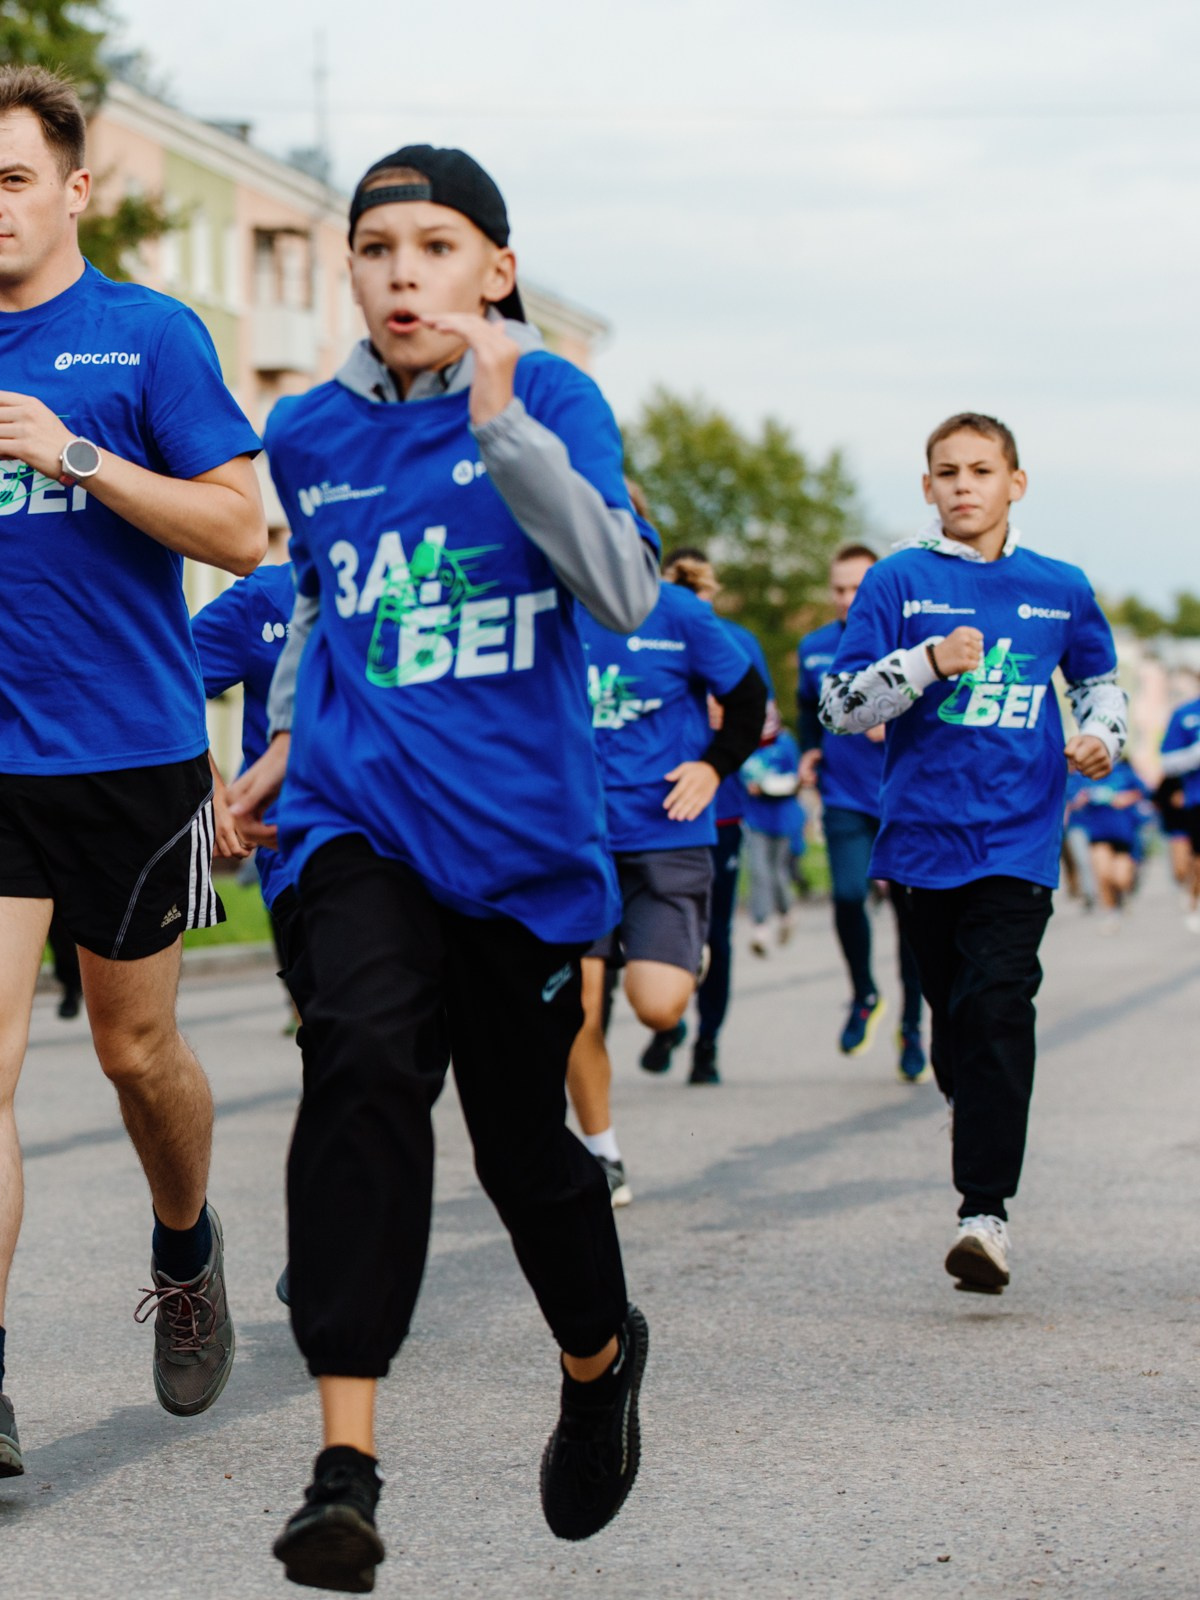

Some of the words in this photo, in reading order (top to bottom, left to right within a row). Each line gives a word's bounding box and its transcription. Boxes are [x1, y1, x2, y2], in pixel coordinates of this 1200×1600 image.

[73, 352, 140, 366] РОСАТОМ
[328, 525, 448, 618] ЗА!
[397, 587, 557, 687] БЕГ
